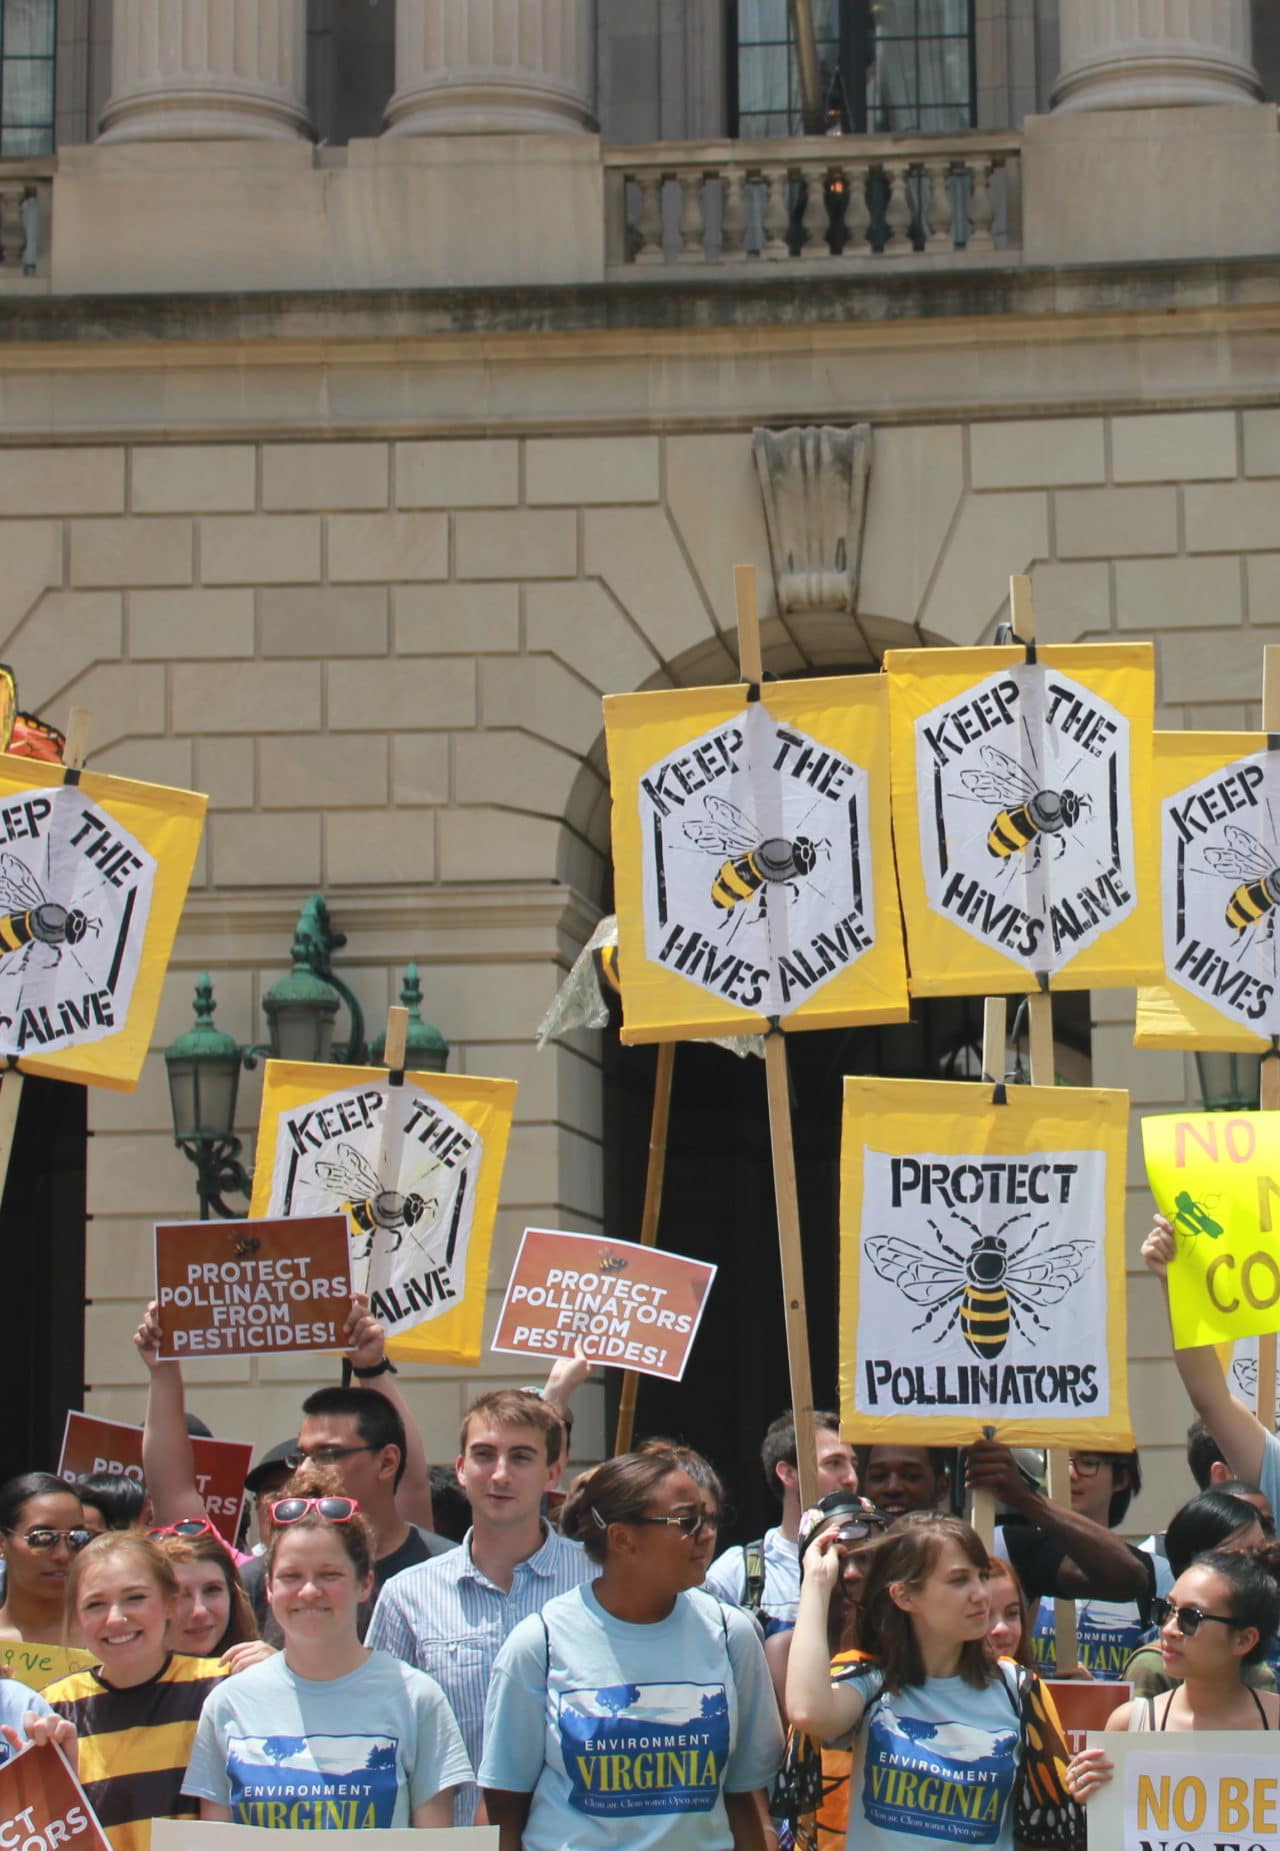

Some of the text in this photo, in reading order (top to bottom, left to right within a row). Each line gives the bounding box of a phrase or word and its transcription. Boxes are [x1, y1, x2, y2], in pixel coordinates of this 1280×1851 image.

[923, 679, 1117, 767] KEEP THE
[641, 728, 854, 818] KEEP THE
[1169, 764, 1265, 845] KEEP
[0, 798, 144, 888] EP THE
[287, 1090, 473, 1169] KEEP THE
[1175, 1119, 1256, 1168] NO
[890, 1158, 1078, 1208] PROTECT
[160, 1276, 348, 1306] POLLINATORS
[187, 1257, 310, 1284] PROTECT
[546, 1268, 668, 1307] PROTECT
[212, 1303, 290, 1327] FROM
[510, 1284, 693, 1334] POLLINATORS
[556, 1310, 631, 1339] FROM
[172, 1321, 336, 1351] PESTICIDES!
[865, 1359, 1099, 1407] POLLINATORS
[585, 1734, 710, 1751] ENVIRONMENT
[576, 1750, 717, 1792] VIRGINIA
[879, 1751, 998, 1782] ENVIRONMENT
[244, 1784, 372, 1798] ENVIRONMENT
[872, 1765, 999, 1822] VIRGINIA
[1137, 1774, 1207, 1832] NO
[239, 1799, 376, 1830] VIRGINIA
